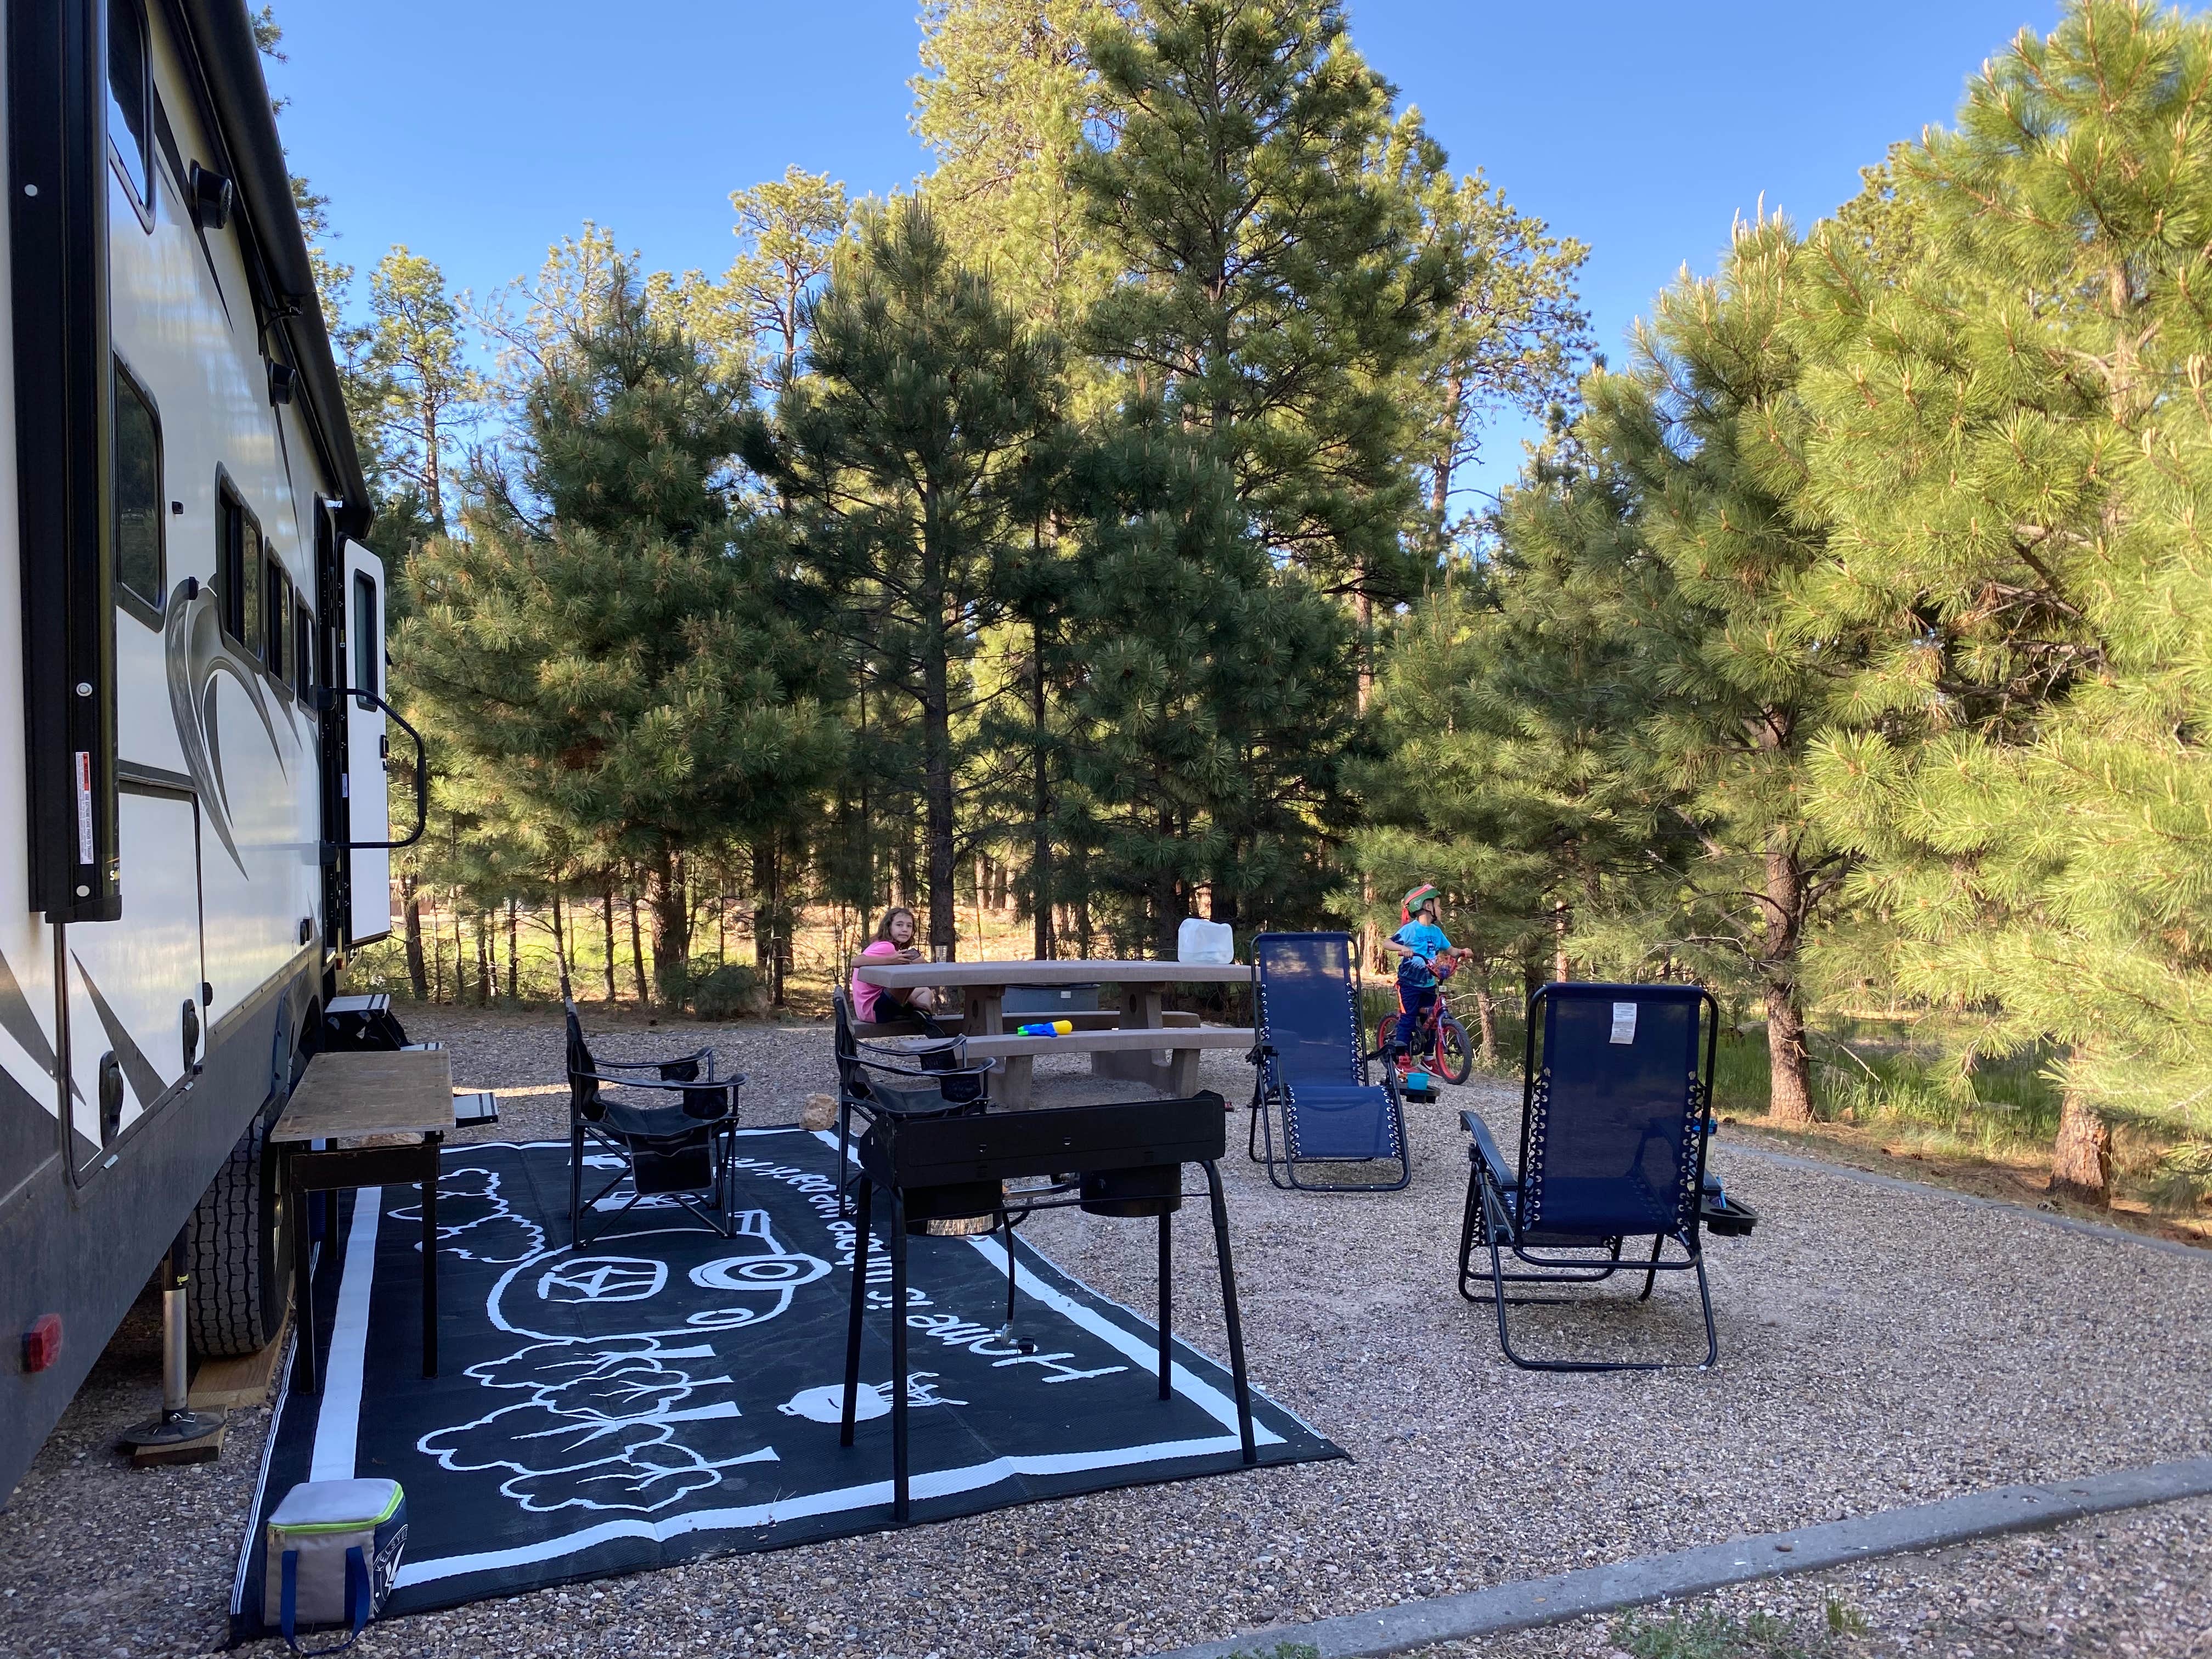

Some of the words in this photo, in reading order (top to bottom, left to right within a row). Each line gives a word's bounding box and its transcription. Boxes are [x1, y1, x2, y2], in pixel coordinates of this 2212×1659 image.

[751, 1166, 838, 1193] park
[826, 1221, 892, 1284] where
[866, 1287, 934, 1310] is
[906, 1314, 1129, 1384] Home
